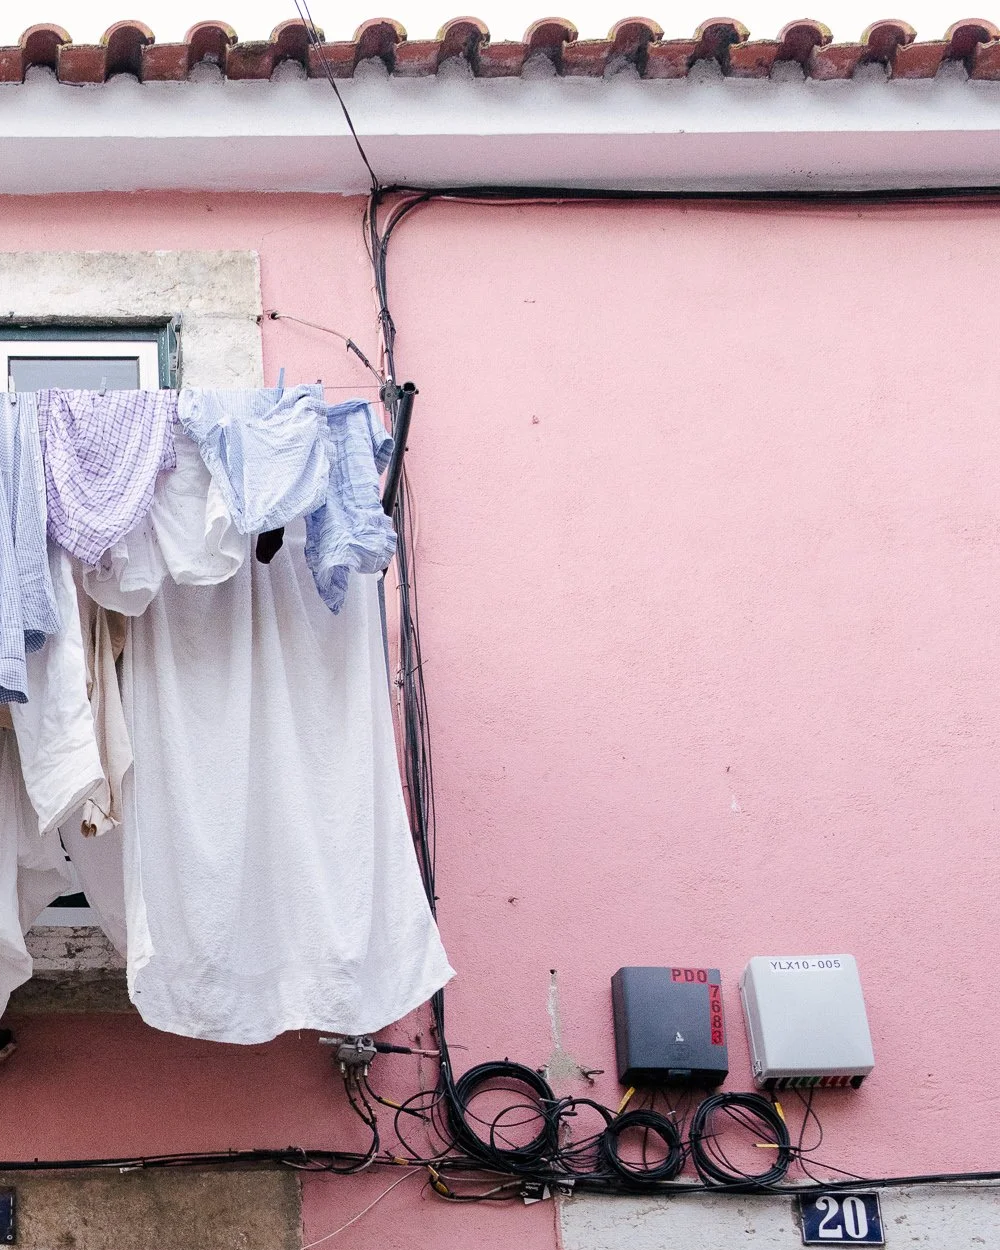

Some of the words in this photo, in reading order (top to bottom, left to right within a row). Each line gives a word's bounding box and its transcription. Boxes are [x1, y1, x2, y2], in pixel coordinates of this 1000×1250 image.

[671, 968, 707, 983] PDO
[770, 959, 841, 970] YLX10-005
[710, 985, 722, 1045] 7683
[815, 1196, 869, 1239] 20
